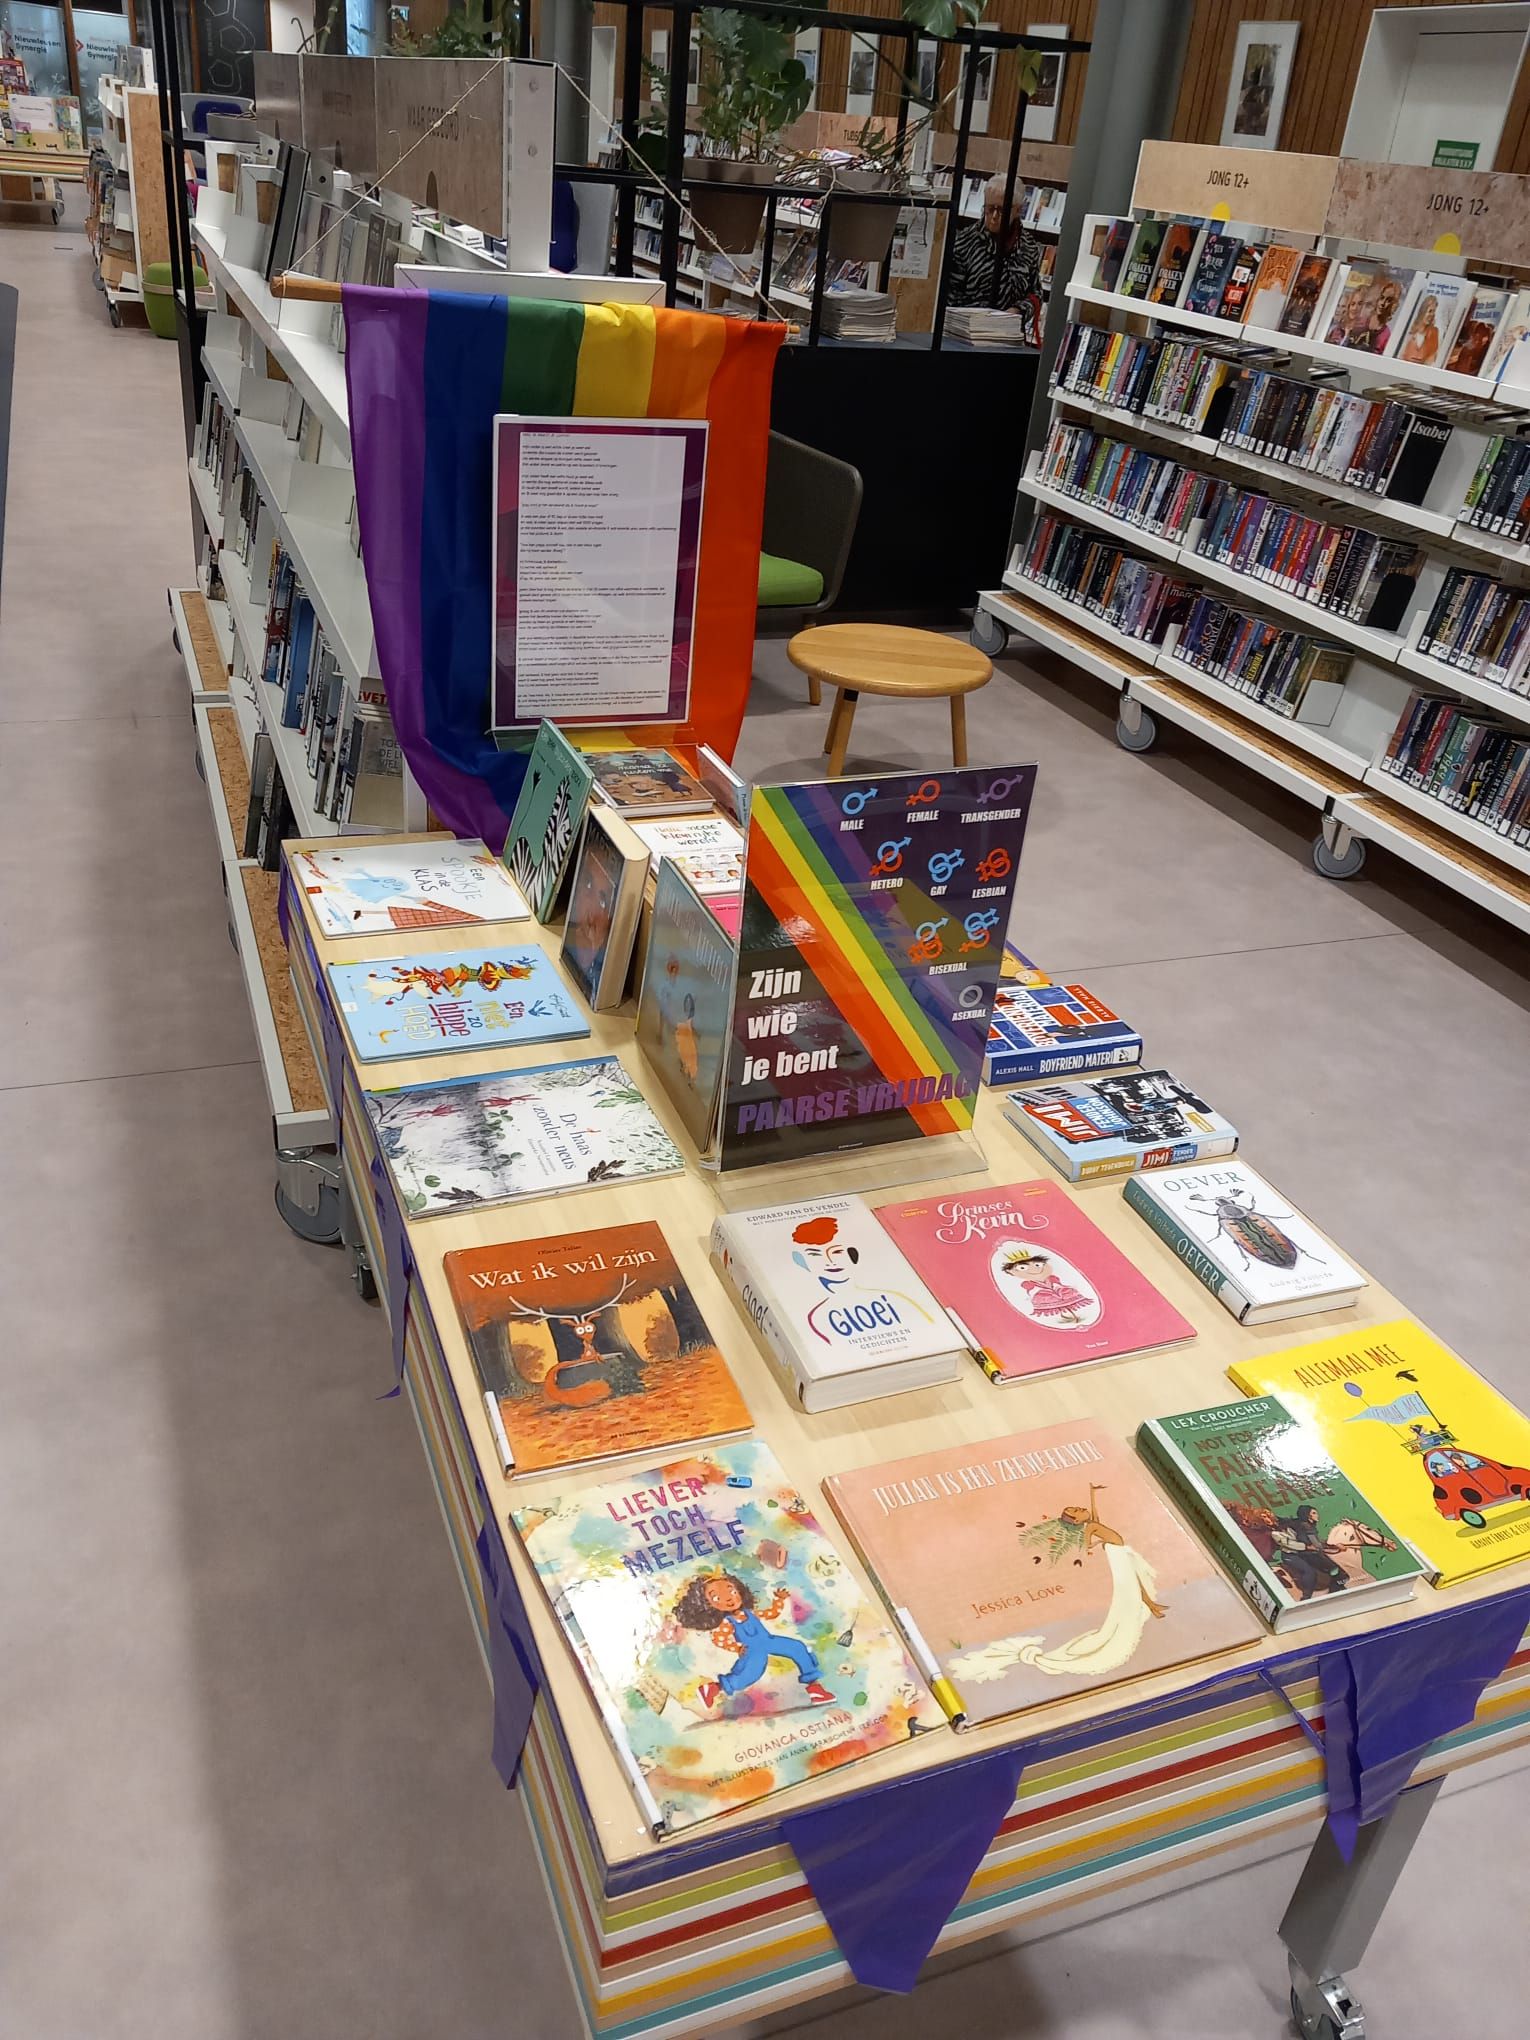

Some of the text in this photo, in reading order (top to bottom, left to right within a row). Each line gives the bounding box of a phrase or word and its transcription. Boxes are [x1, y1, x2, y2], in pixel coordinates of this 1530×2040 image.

[1206, 169, 1250, 189] JONG 12+
[1426, 193, 1490, 216] JONG 12+
[1412, 421, 1451, 440] Isabel
[840, 819, 865, 832] MALE
[906, 809, 940, 823] FEMALE
[960, 808, 1021, 825] TRANSGENDER
[411, 868, 440, 893] KLAS
[440, 856, 484, 900] SPOOKJE
[870, 877, 904, 891] HETERO
[930, 885, 948, 897] GAY
[972, 886, 1007, 899] LESBIAN
[928, 962, 968, 976] BISEXUAL
[748, 968, 803, 1000] Zijn
[432, 1000, 472, 1038] hippe
[502, 1001, 524, 1019] Een
[951, 1008, 987, 1021] ASEXUAL
[746, 1009, 799, 1040] wie
[741, 1044, 840, 1086] je bent
[995, 1051, 1115, 1076] ALEXIS HALL BOYFRIEND MATERI
[736, 1071, 974, 1135] PAARSE VRIJDAG
[1086, 1096, 1127, 1126] JOHNSON
[1033, 1104, 1100, 1140] JIMI
[1076, 1104, 1108, 1129] FENDER
[532, 1105, 562, 1144] zonder
[554, 1143, 577, 1171] neus
[559, 1112, 593, 1157] De haas
[1142, 1151, 1170, 1168] JIMI
[1163, 1171, 1246, 1193] OEVER
[746, 1201, 850, 1222] EDWARD VAN DE VENDEL
[937, 1200, 1013, 1226] Prinses
[936, 1209, 1050, 1244] Kevin
[468, 1248, 659, 1290] Wat ik wil zijn
[1176, 1238, 1220, 1291] OEVER
[848, 1330, 898, 1345] INTERVIEWS
[860, 1336, 908, 1350] GEDICHTEN
[1293, 1343, 1406, 1389] ALLEMAAL MEE
[1171, 1416, 1197, 1430] LEX
[1199, 1402, 1272, 1423] CROUCHER
[1194, 1430, 1254, 1453] NOT FOR
[606, 1476, 707, 1523] LIEVER
[873, 1478, 940, 1516] JULIAN
[941, 1472, 963, 1497] IS
[958, 1464, 997, 1493] EEN
[631, 1503, 707, 1543] TOCH
[621, 1518, 747, 1579] MEZELF
[970, 1581, 1066, 1620] Jessica Love
[734, 1713, 852, 1764] GIOVANCA OSTIANA
